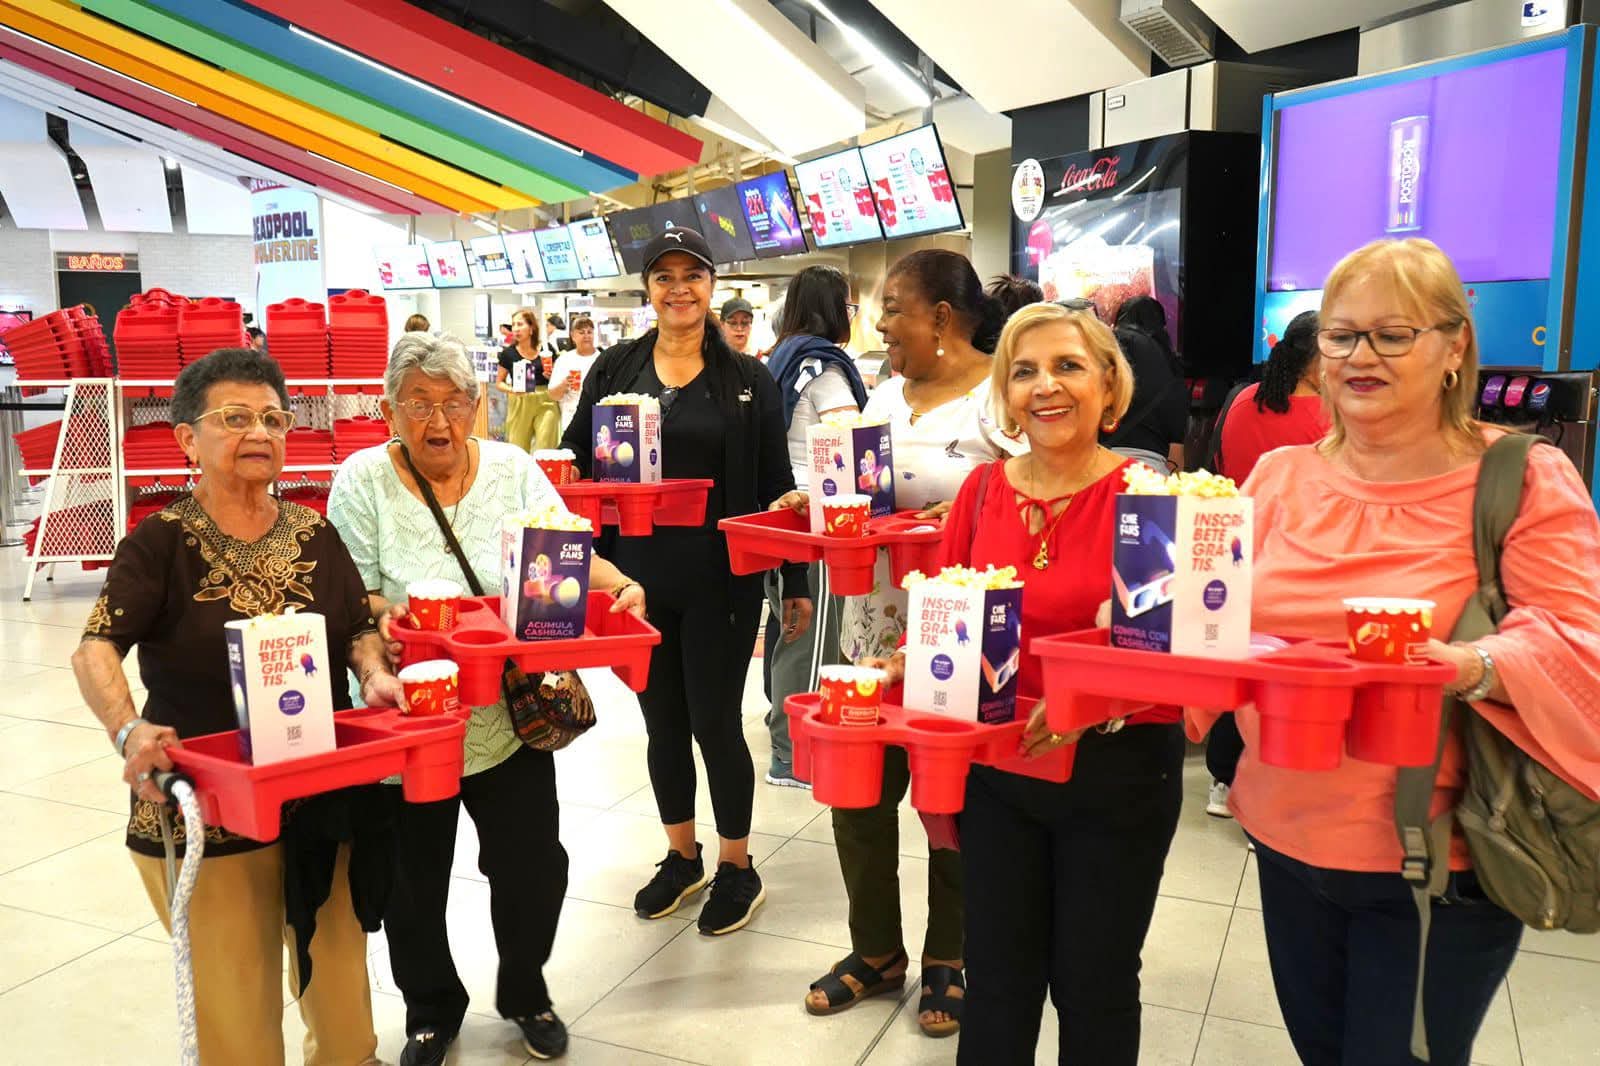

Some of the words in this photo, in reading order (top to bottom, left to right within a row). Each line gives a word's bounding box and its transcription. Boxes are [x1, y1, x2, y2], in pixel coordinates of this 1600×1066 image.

[68, 253, 124, 270] BAÑOS
[813, 447, 830, 457] BETE
[1193, 528, 1226, 542] BETE
[562, 543, 583, 551] CINE
[1192, 543, 1230, 557] GRA-
[560, 551, 584, 560] FANS
[1192, 558, 1216, 572] TIS.
[921, 610, 949, 623] BETE
[527, 621, 573, 629] ACUMULA
[920, 622, 953, 635] GRA-
[525, 628, 576, 636] CASHBACK
[259, 630, 314, 651] INSCRÍ-
[920, 634, 941, 647] TIS.
[260, 649, 293, 663] BETE
[261, 662, 299, 675] GRA-
[263, 674, 287, 688] TIS.
